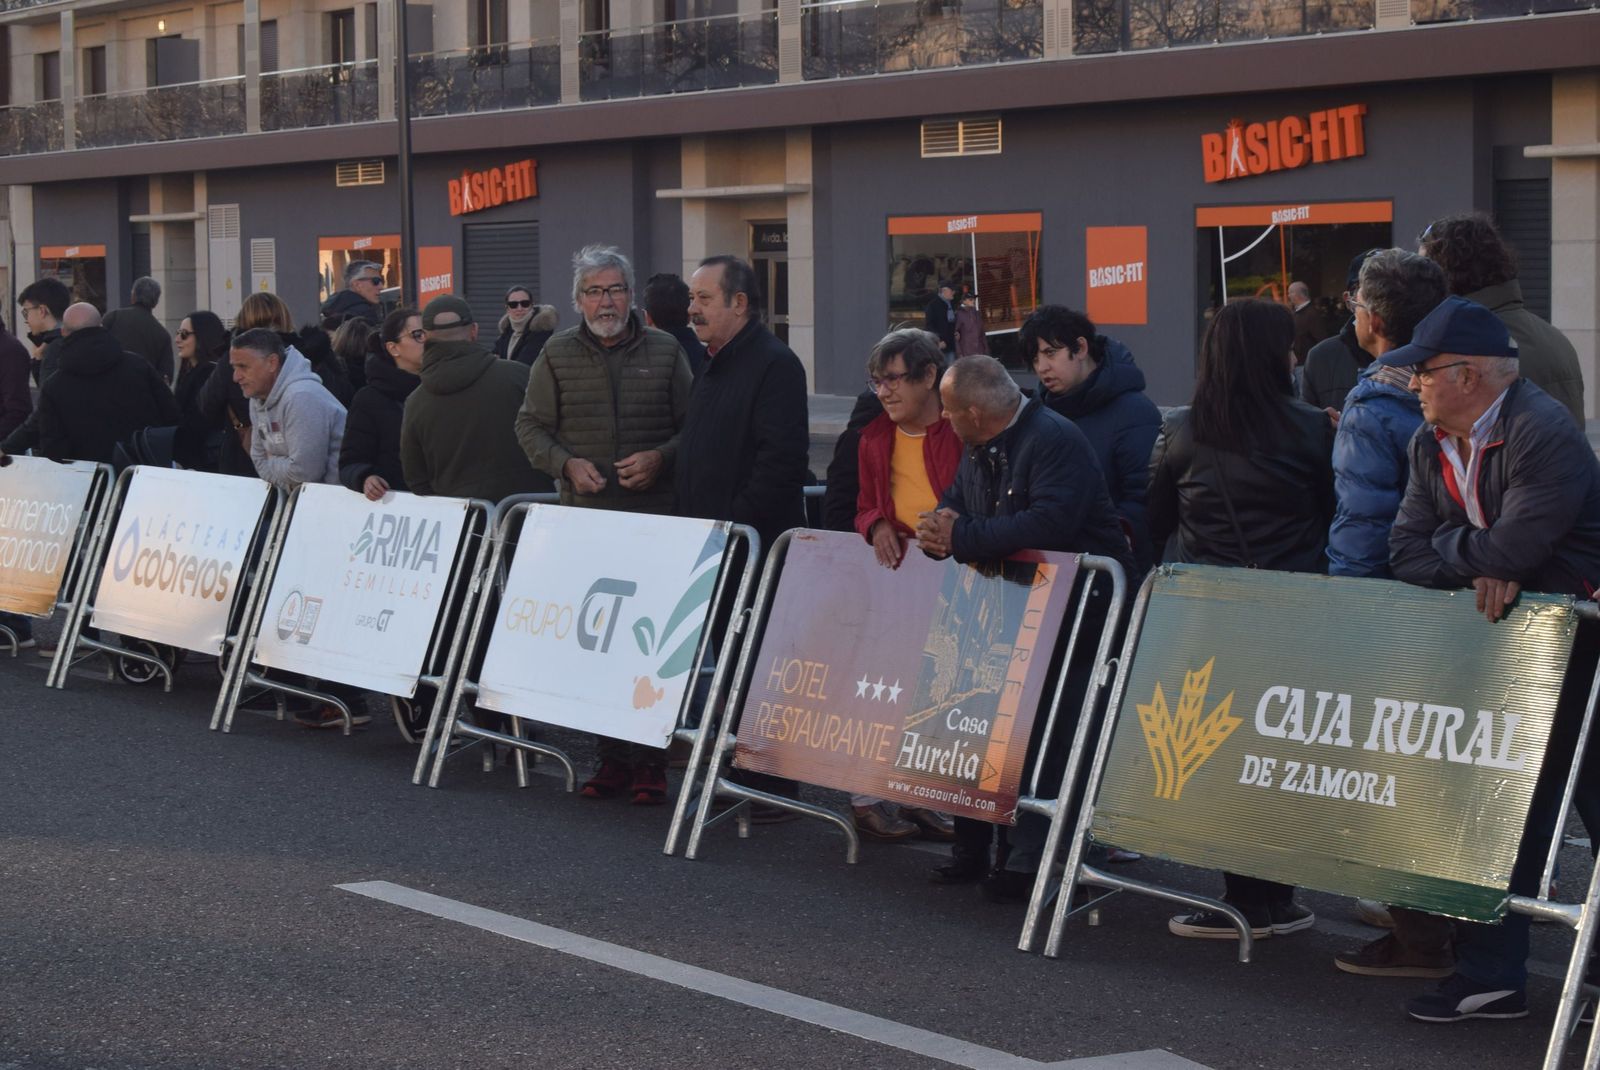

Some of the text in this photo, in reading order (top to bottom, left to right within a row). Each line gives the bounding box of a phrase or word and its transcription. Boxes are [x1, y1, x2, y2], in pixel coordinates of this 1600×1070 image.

[1201, 104, 1366, 183] BASIC-FIT
[448, 160, 536, 216] BASIC-FIT
[947, 216, 977, 232] BASIC-FIT
[1272, 206, 1310, 224] BASIC-FIT
[420, 273, 451, 293] BASIC-FIT
[1089, 262, 1143, 288] BASIC-FIT
[349, 512, 441, 574] ARIMA
[133, 543, 233, 602] cobreros
[343, 569, 433, 600] SEMILLAS
[506, 597, 573, 640] GRUPO
[766, 656, 830, 700] HOTEL
[753, 701, 895, 762] RESTAURANTE
[946, 708, 988, 736] Casa
[1255, 685, 1527, 771] CAJA RURAL
[887, 780, 996, 812] www.casaaurelia.com
[1239, 755, 1397, 807] DE ZAMORA
